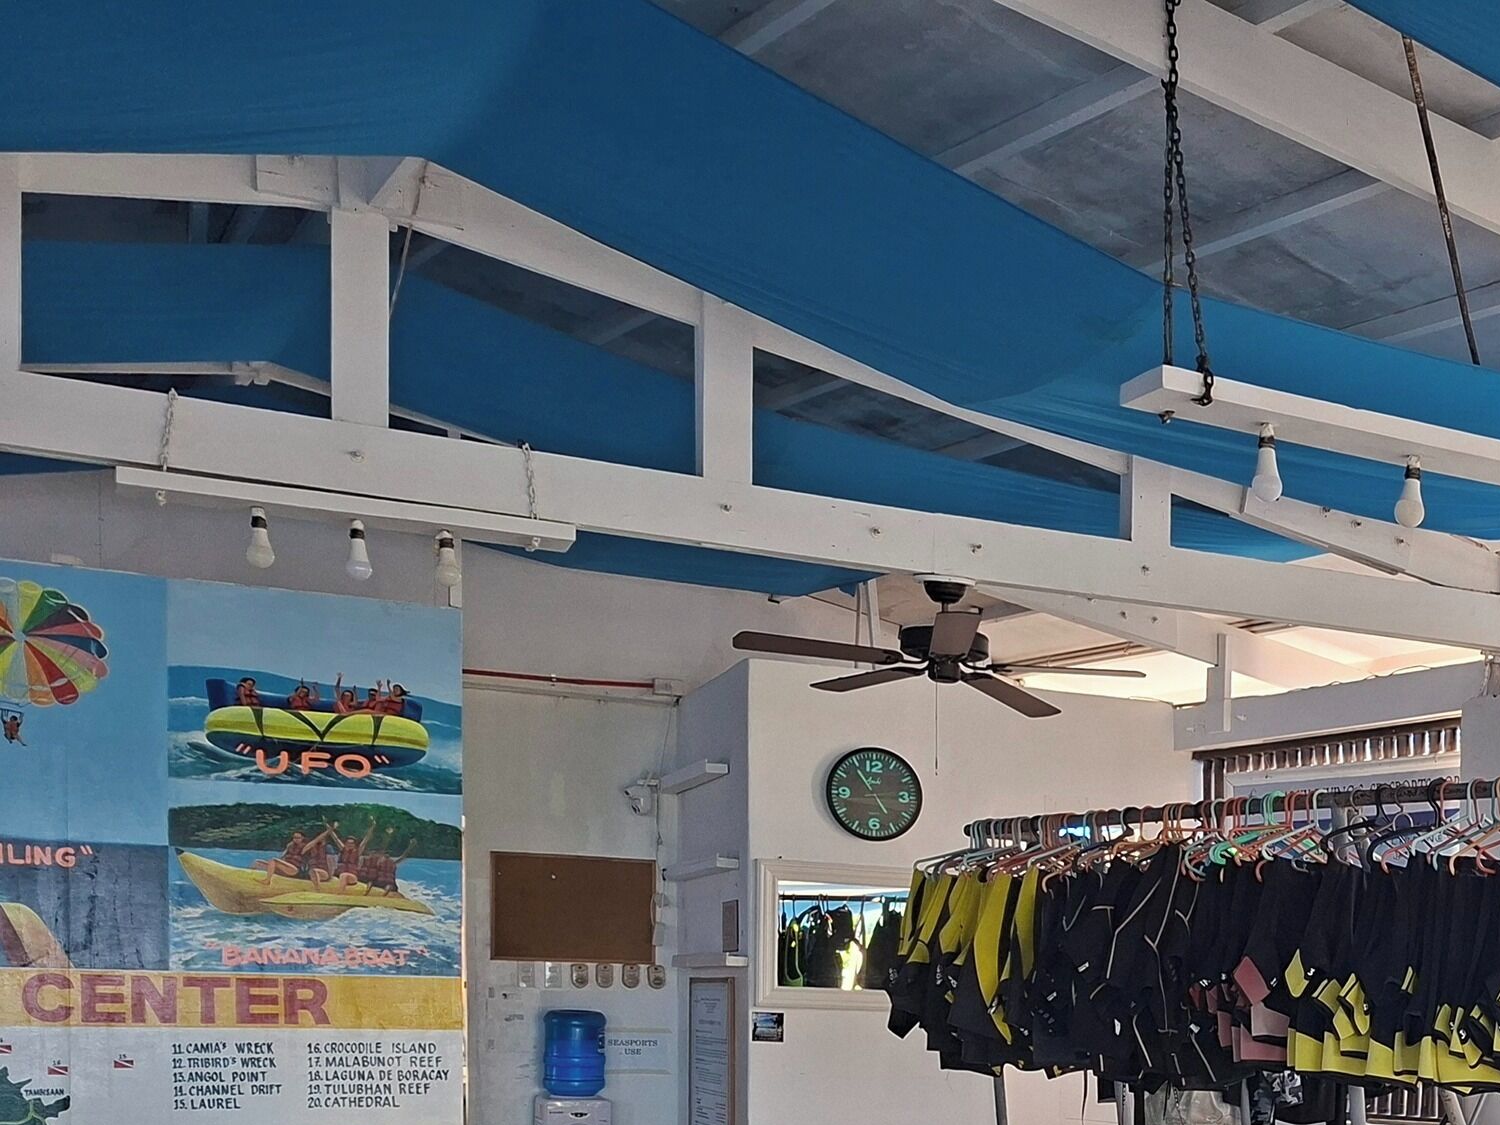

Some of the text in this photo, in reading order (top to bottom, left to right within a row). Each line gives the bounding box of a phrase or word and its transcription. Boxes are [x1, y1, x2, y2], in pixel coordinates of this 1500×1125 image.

[865, 760, 883, 773] 12
[838, 786, 851, 799] 9
[898, 791, 910, 804] 3
[868, 817, 881, 830] 6
[22, 972, 332, 1025] CENTER
[235, 1042, 274, 1054] WRECK
[307, 1042, 437, 1054] 16. CROCODILE ISLAND
[607, 1039, 658, 1047] SEASPORTS
[624, 1048, 642, 1056] USE
[240, 1057, 277, 1069] WRECK
[308, 1055, 443, 1068] 17. MALABUNOT REEF
[187, 1071, 225, 1083] ANGOL
[232, 1071, 268, 1083] POINT
[325, 1070, 375, 1081] LAGUNA
[379, 1069, 393, 1081] DE
[397, 1069, 450, 1081] BORACAY
[188, 1084, 245, 1096] CHANNEL
[251, 1083, 282, 1095] DRIFT
[324, 1083, 392, 1095] TULUBHAN
[399, 1082, 431, 1095] REEF
[190, 1097, 241, 1110] LAUREL
[307, 1096, 401, 1108] 20. CATHEDRAL
